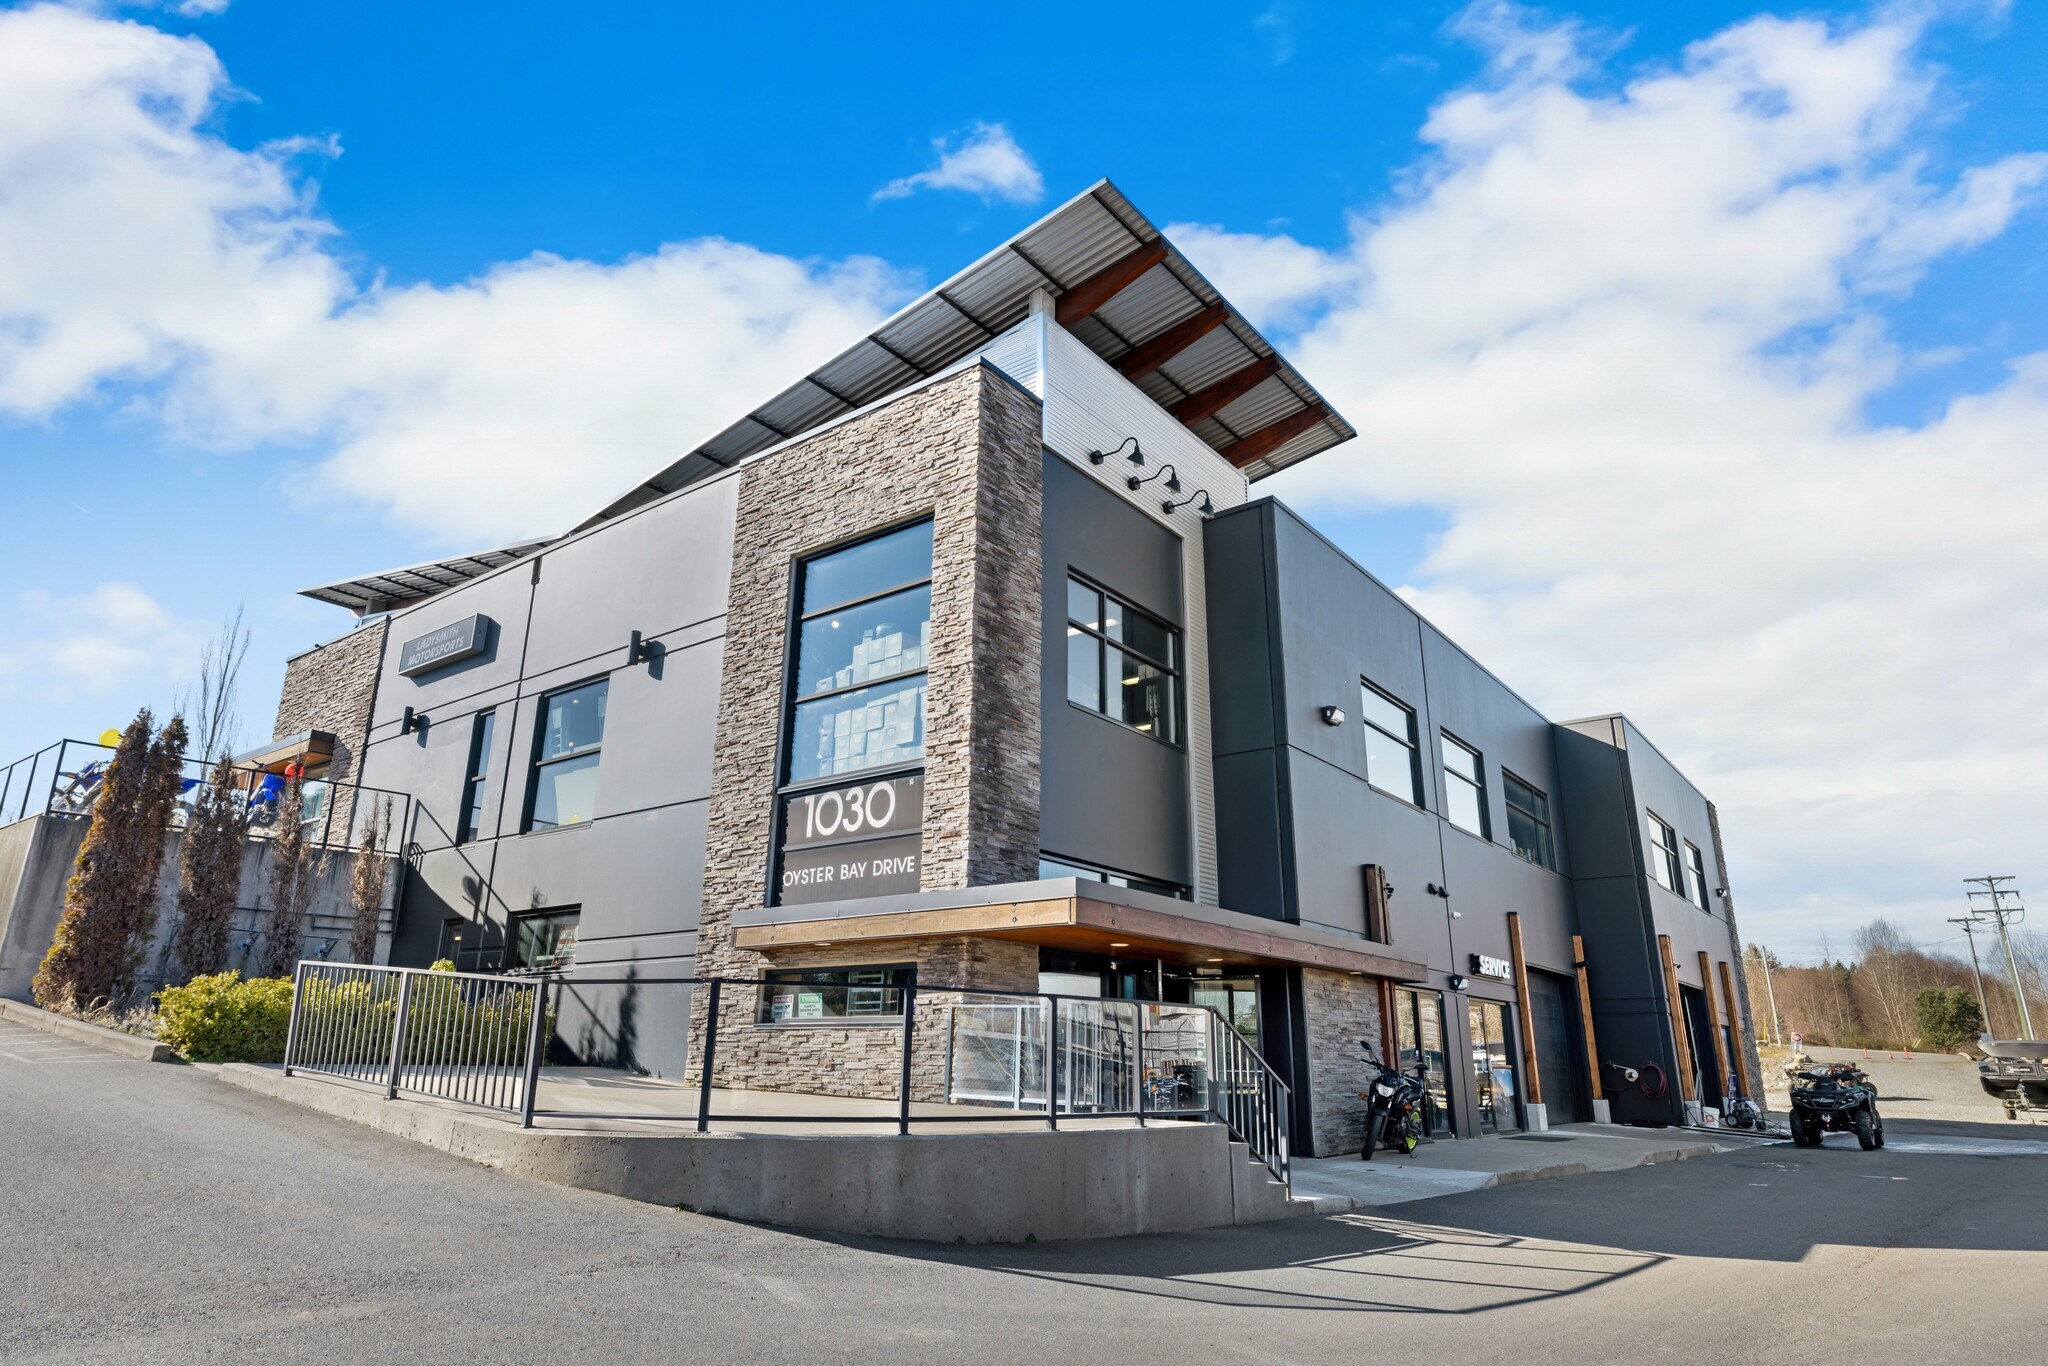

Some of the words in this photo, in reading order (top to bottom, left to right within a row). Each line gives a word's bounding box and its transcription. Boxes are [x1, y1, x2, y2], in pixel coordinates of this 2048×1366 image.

[407, 636, 464, 666] MOTORSPORTS
[417, 625, 460, 651] LADYSMITH
[804, 781, 895, 838] 1030
[783, 866, 834, 886] OYSTER
[840, 861, 867, 880] BAY
[873, 856, 915, 876] DRIVE
[1479, 955, 1511, 979] SERVICE
